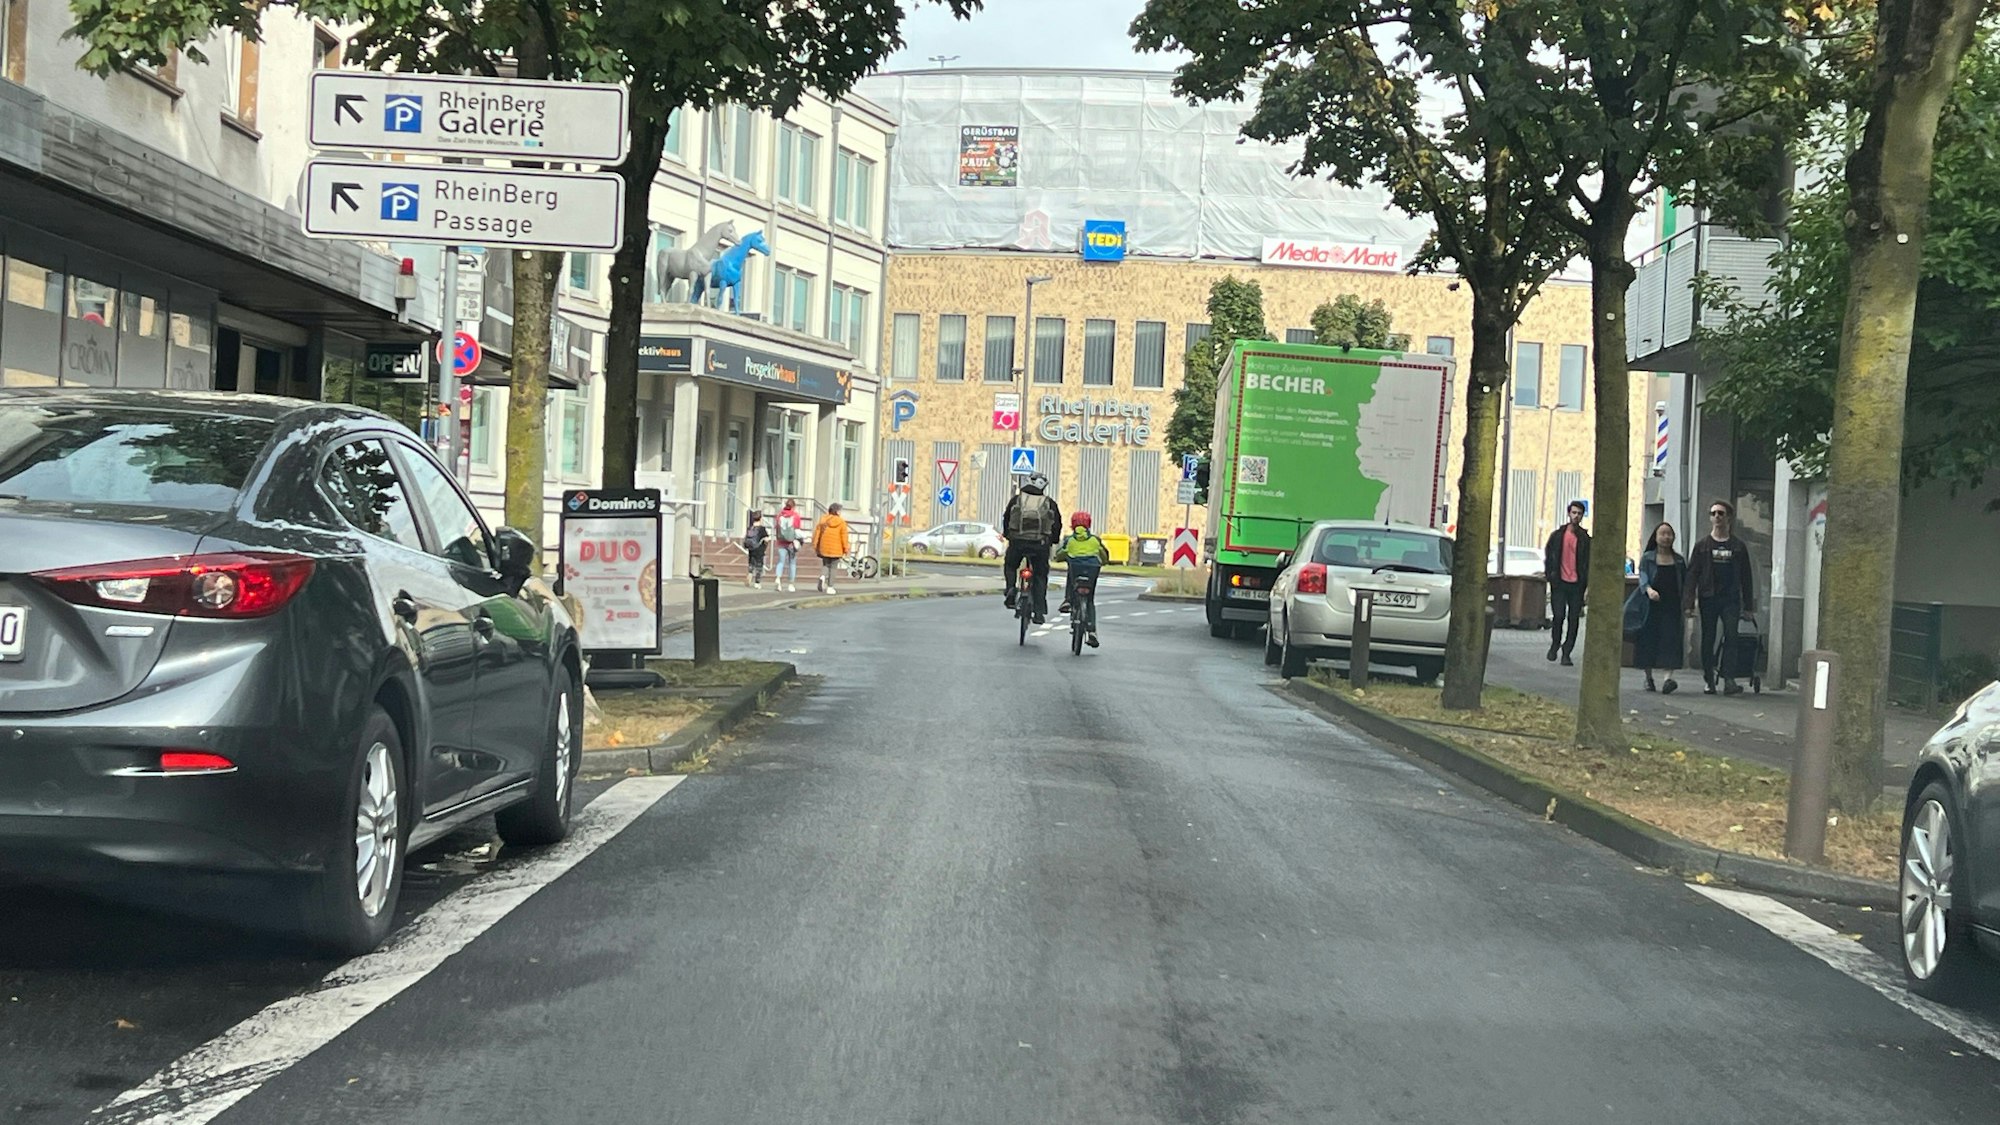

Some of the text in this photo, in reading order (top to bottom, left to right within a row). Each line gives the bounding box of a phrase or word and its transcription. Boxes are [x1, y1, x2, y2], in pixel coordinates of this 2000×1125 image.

[439, 91, 546, 119] RheinBerg
[438, 110, 545, 137] Galerie
[963, 126, 1017, 136] GERÜSTBAU
[961, 157, 991, 168] PAUL
[435, 179, 558, 211] RheinBerg
[433, 209, 533, 238] Passage
[1268, 242, 1398, 267] Media Markt
[368, 352, 422, 375] OPEN!
[638, 346, 682, 357] ektivhaus
[1039, 394, 1152, 424] RheinBerg
[1039, 412, 1151, 446] Galerie
[589, 496, 656, 511] Domino's
[579, 539, 642, 564] DUO
[1393, 593, 1412, 605] 499
